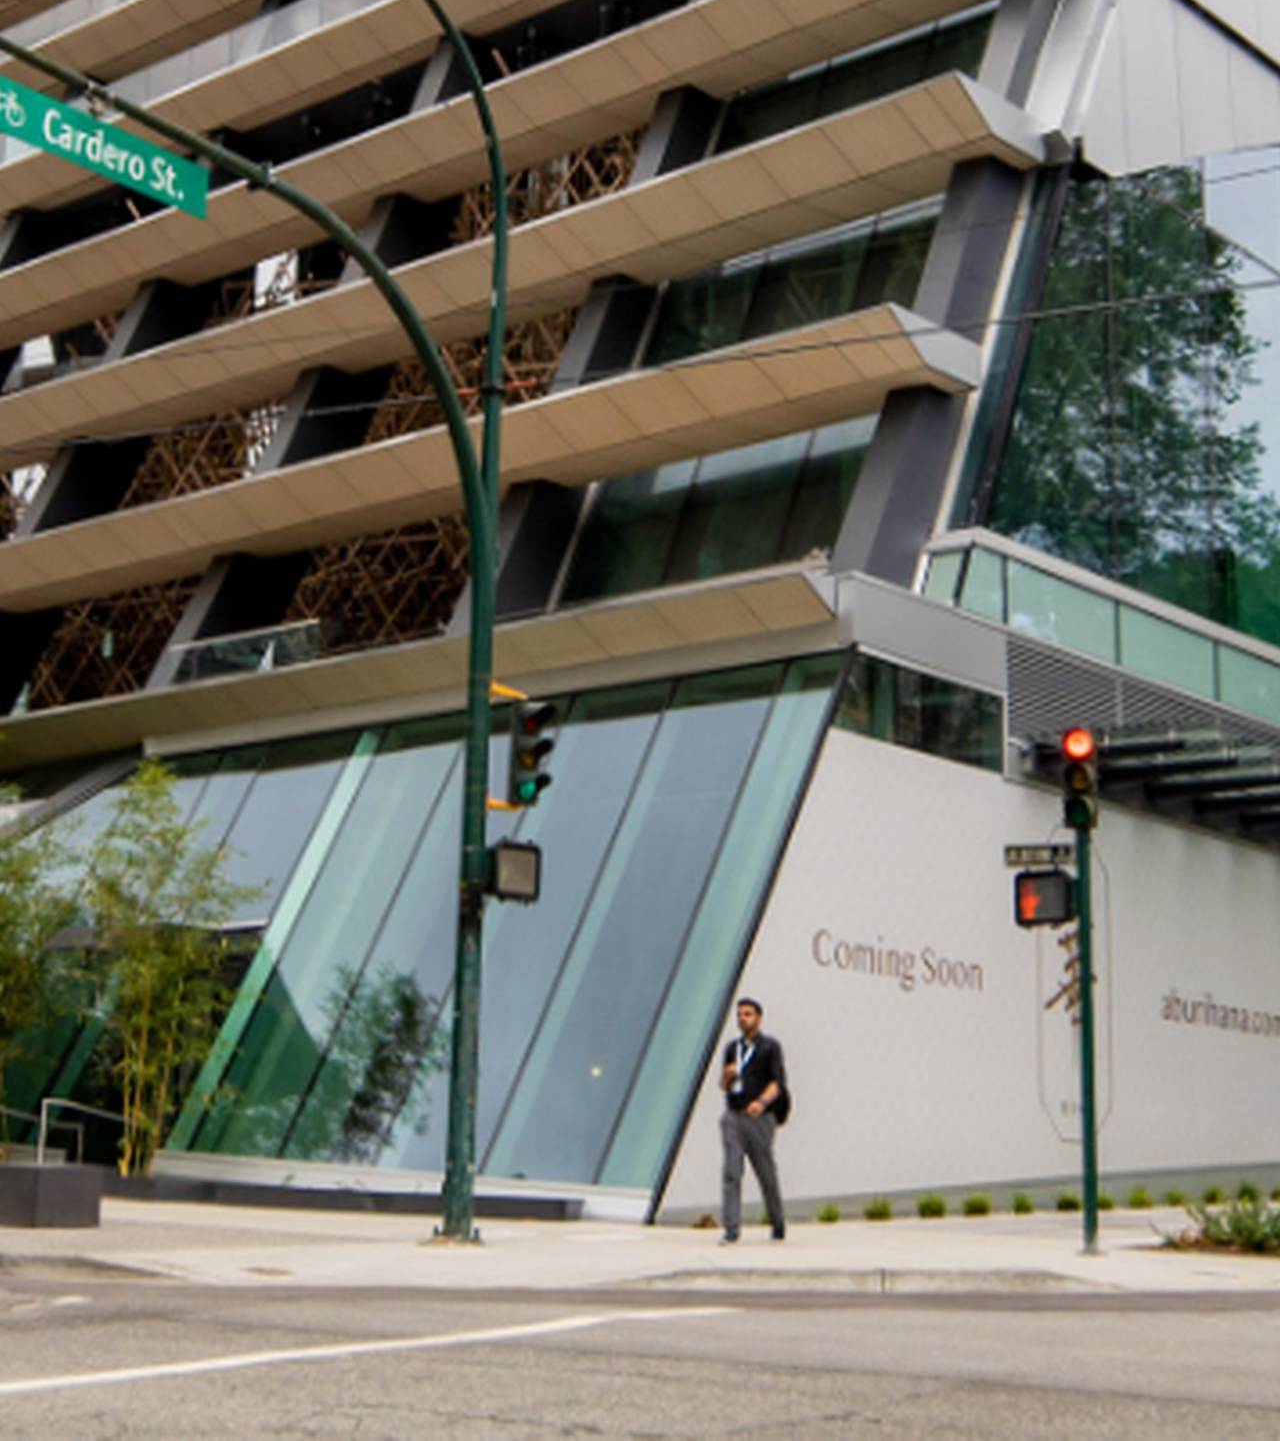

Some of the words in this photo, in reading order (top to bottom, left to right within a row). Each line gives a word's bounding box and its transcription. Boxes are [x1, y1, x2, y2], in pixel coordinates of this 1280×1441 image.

[43, 108, 145, 181] Cardero
[150, 156, 184, 201] St.
[812, 928, 916, 992] Coming
[921, 946, 983, 992] Soon
